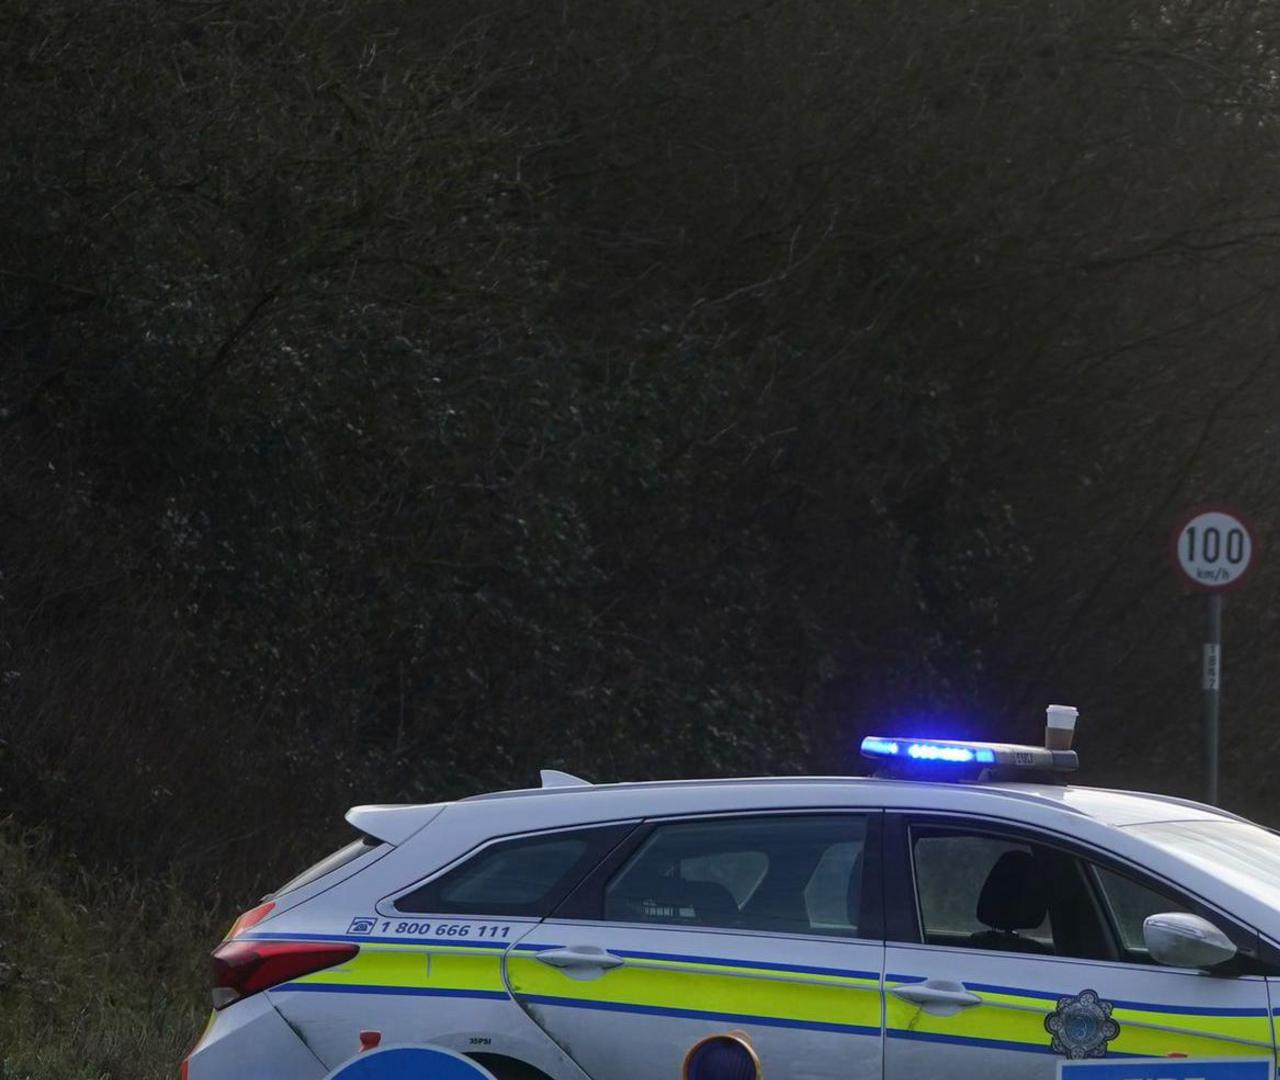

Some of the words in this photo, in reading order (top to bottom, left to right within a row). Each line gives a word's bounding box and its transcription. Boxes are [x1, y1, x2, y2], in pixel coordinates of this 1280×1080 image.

[1186, 526, 1244, 565] 100
[1196, 567, 1230, 581] km/h
[381, 921, 391, 933] 1
[395, 922, 431, 935] 800
[435, 924, 470, 937] 666
[478, 925, 510, 938] 111
